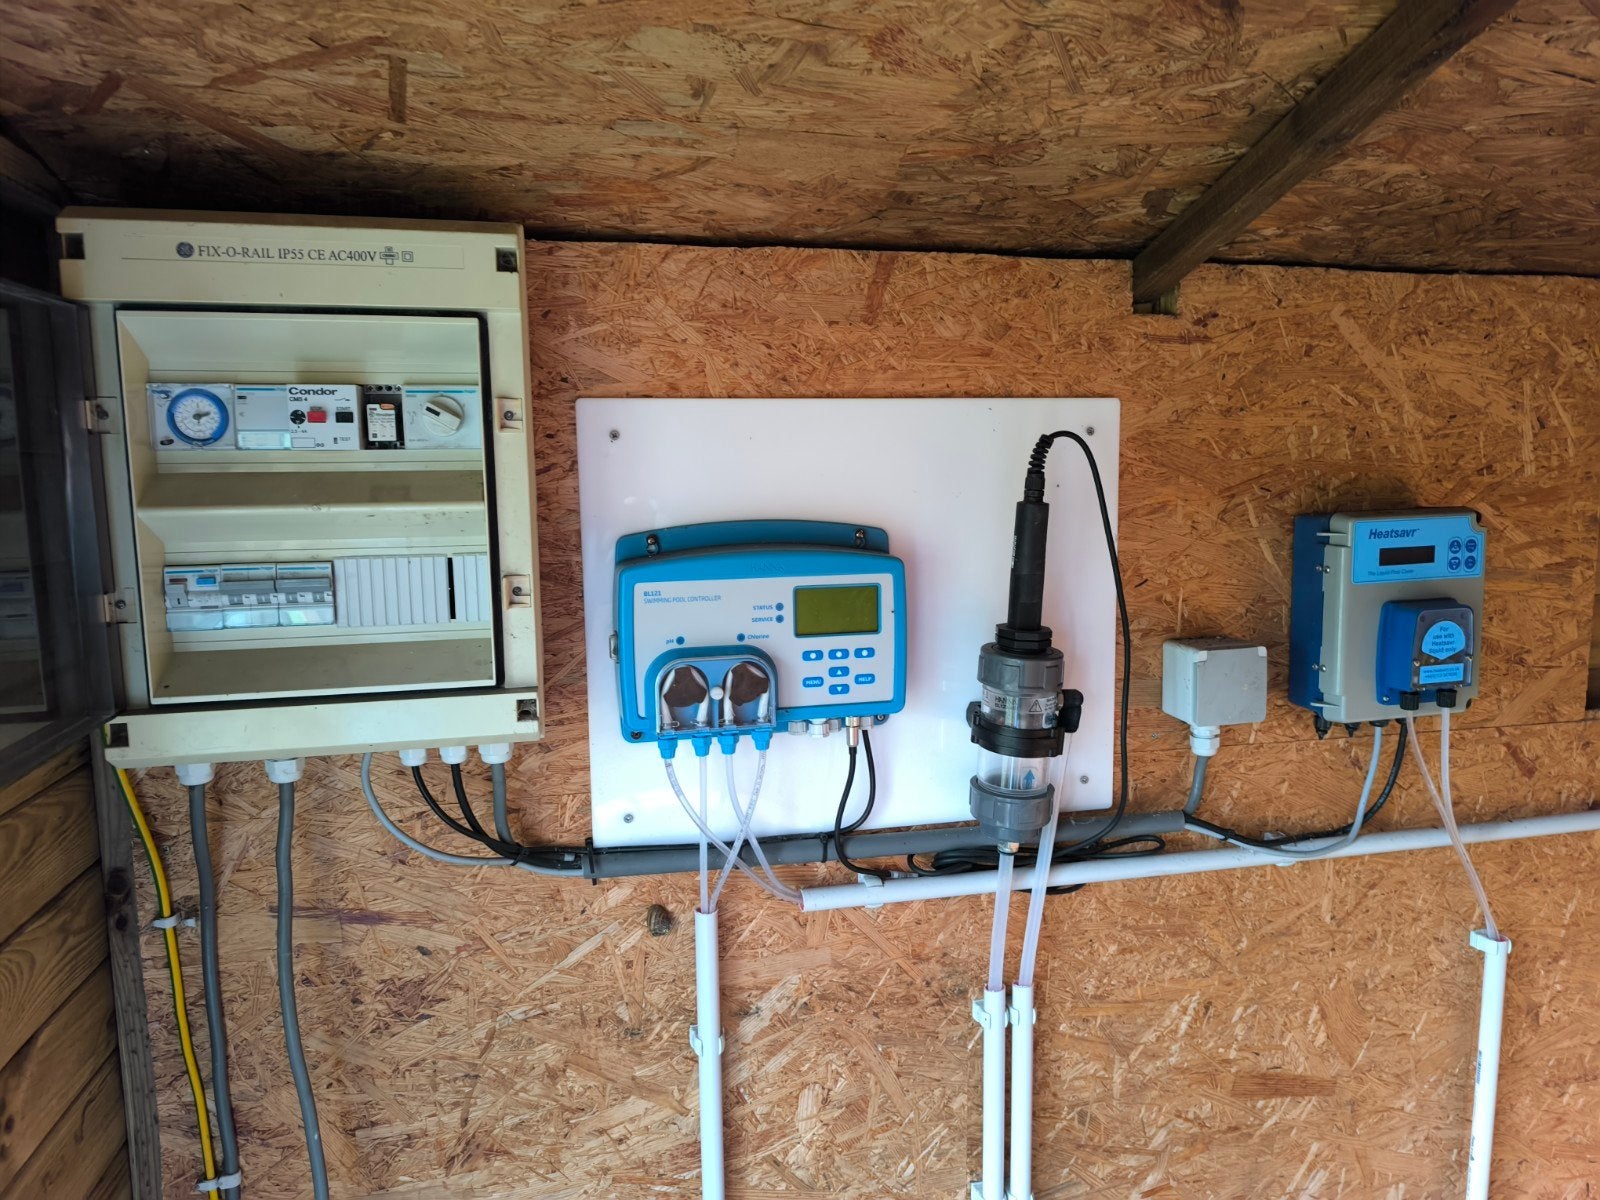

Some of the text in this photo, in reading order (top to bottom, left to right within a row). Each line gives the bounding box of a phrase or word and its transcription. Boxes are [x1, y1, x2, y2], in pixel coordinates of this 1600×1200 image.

[197, 245, 275, 259] FIX-O-RAIL
[278, 248, 304, 260] IP55
[307, 249, 325, 261] CE
[328, 250, 377, 262] AC400V
[288, 387, 337, 395] Condor
[1368, 528, 1417, 540] Heatsavr
[687, 595, 722, 603] CONTROLLER
